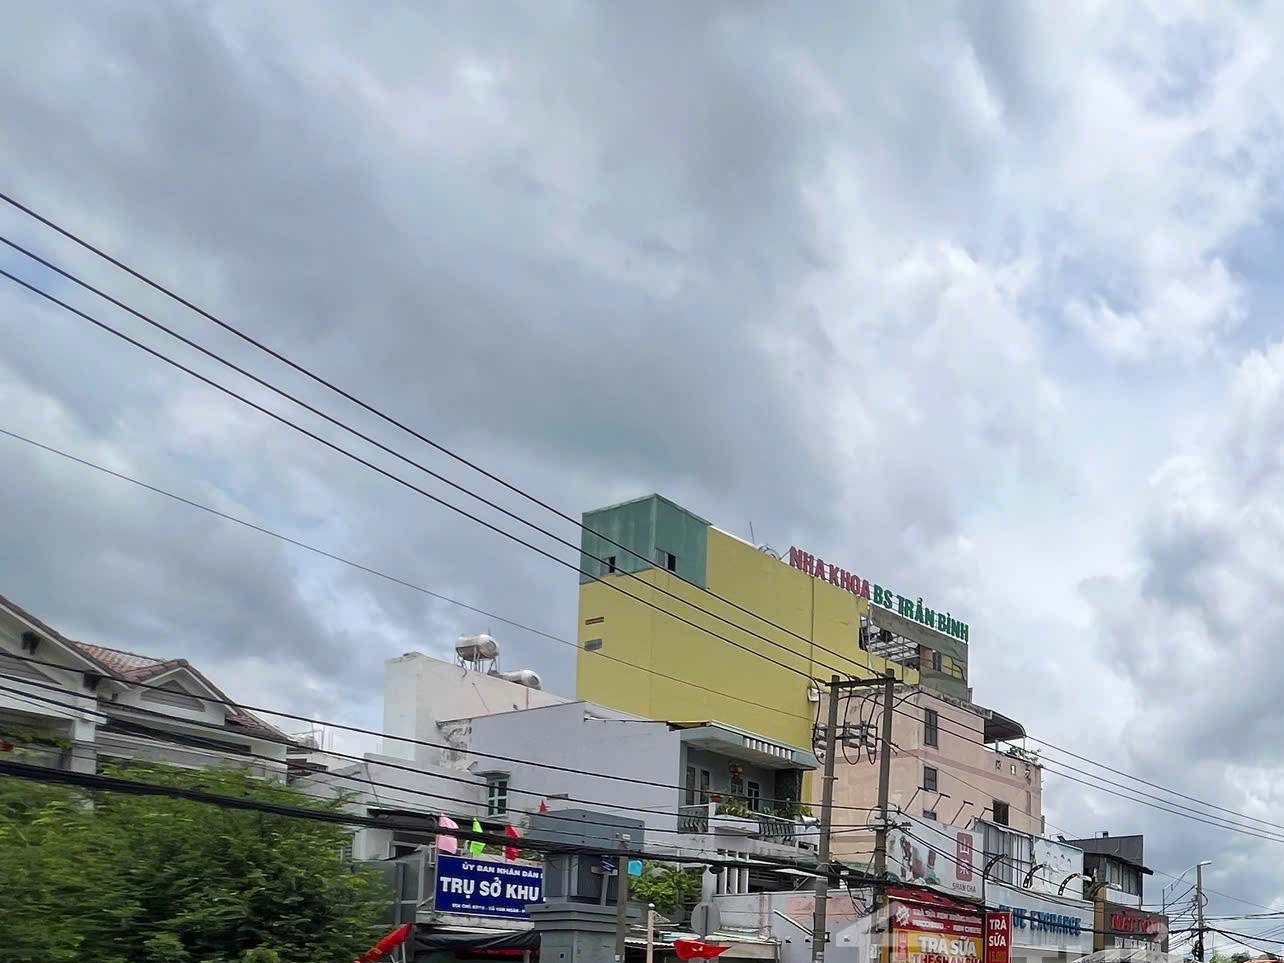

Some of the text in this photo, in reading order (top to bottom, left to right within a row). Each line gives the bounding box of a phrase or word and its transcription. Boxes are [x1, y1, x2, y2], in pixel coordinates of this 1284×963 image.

[790, 545, 826, 581] NHA
[829, 563, 872, 601] KHOA
[873, 583, 894, 610] BS
[937, 612, 969, 644] BÌNH
[462, 861, 540, 879] ỦY BAN NHÂN DÂN
[440, 876, 540, 902] TRỤ SỞ KHU
[989, 916, 1008, 931] TRÀ
[919, 933, 949, 955] TRÀ
[949, 936, 977, 957] SỮA
[988, 934, 1006, 947] SỮA
